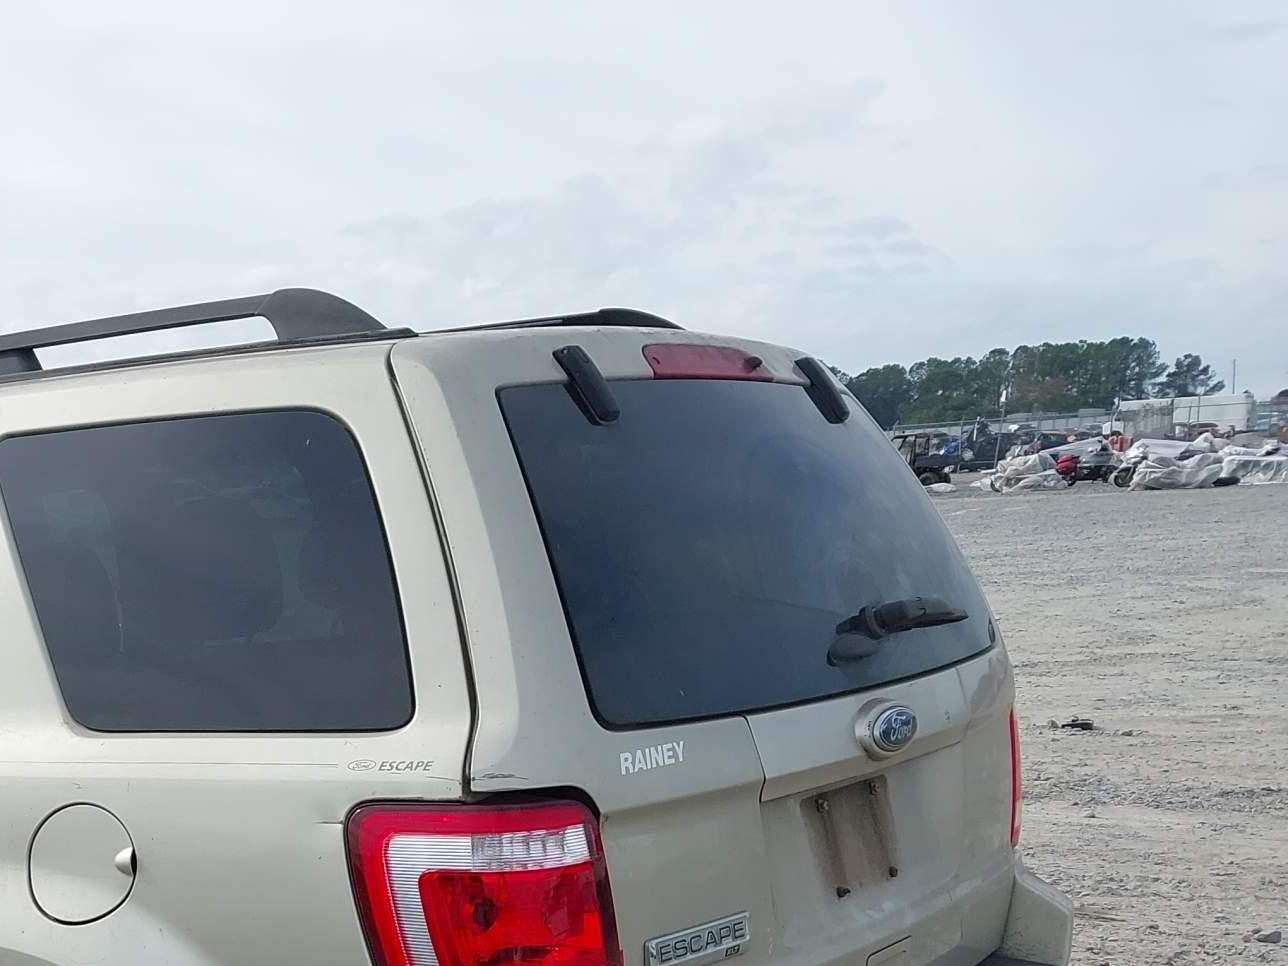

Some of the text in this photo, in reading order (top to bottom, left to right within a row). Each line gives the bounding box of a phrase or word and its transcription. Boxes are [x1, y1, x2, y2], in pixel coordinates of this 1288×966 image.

[890, 713, 913, 741] Ford
[378, 760, 434, 771] ESCAPE
[619, 740, 684, 776] RAINEY
[658, 921, 745, 963] ESCAPE
